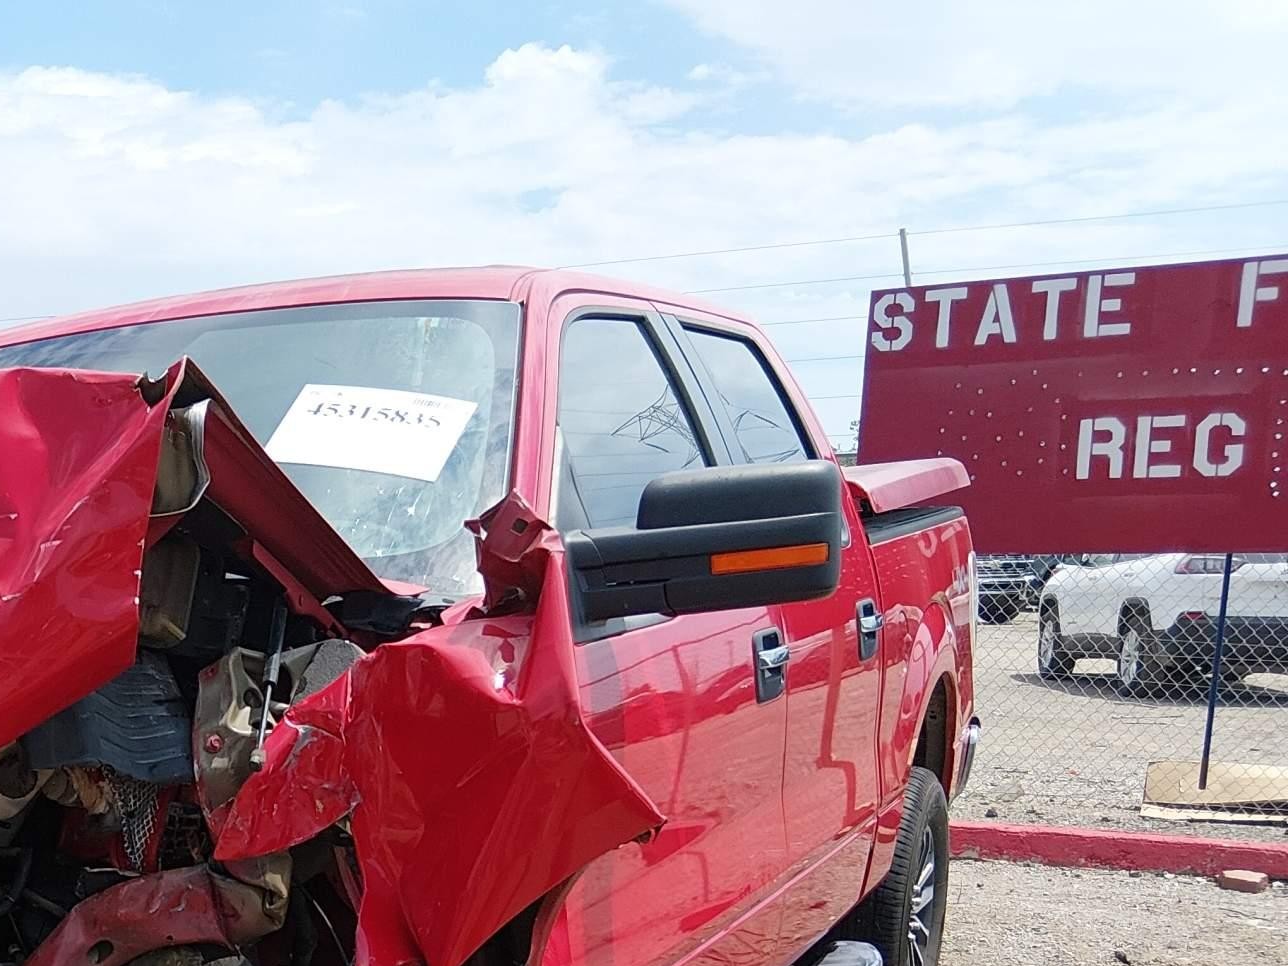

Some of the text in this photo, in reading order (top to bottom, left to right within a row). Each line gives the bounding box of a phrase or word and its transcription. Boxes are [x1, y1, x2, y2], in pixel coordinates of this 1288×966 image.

[871, 272, 1135, 352] STATE
[307, 402, 442, 428] 45315835
[1075, 412, 1247, 480] REG
